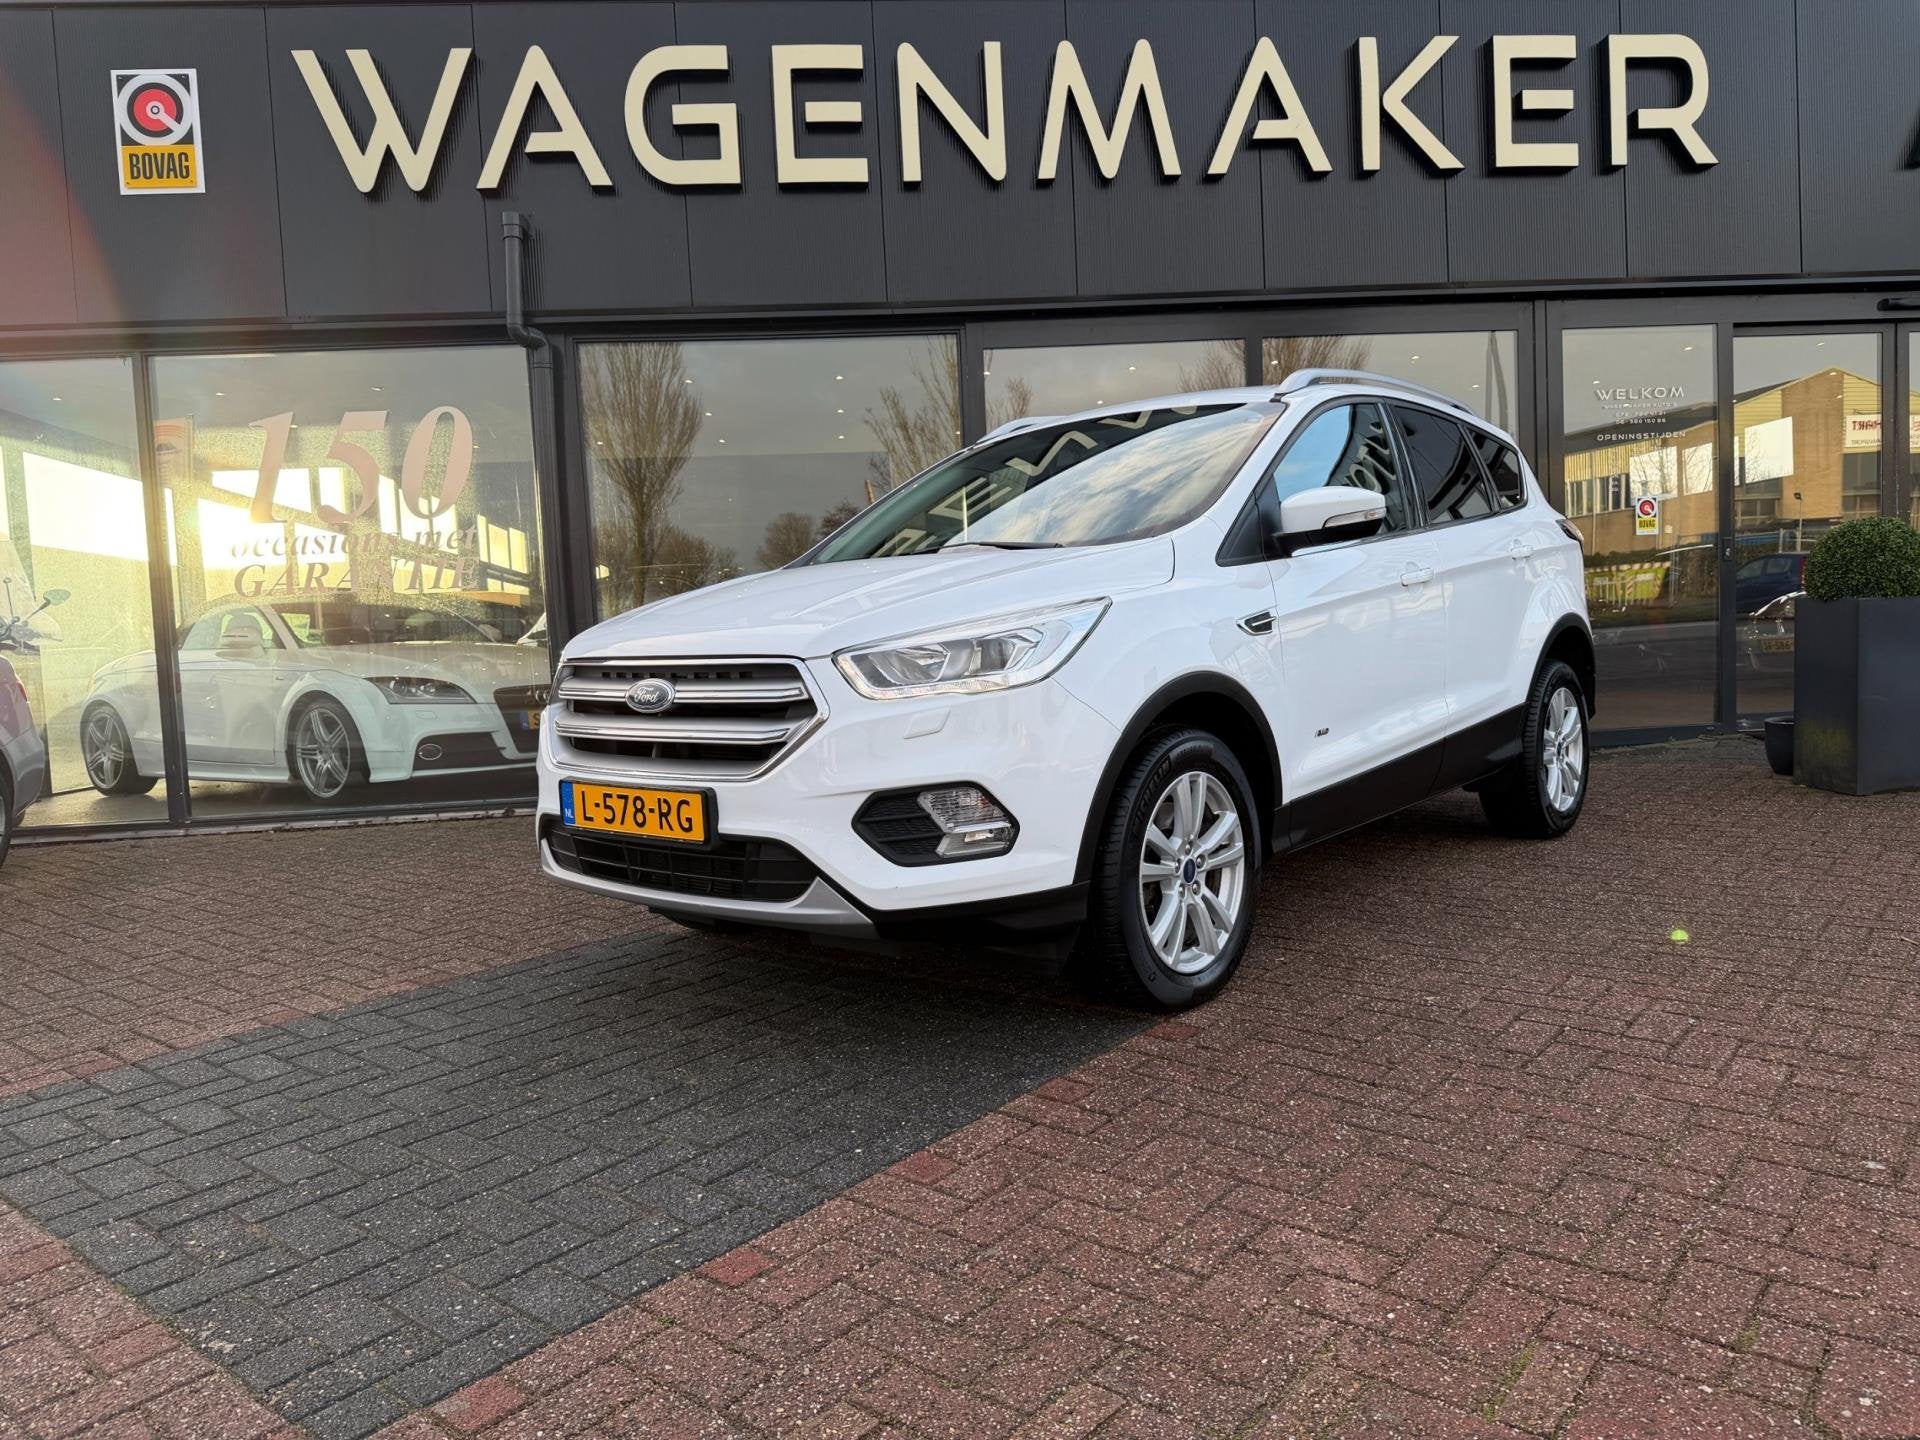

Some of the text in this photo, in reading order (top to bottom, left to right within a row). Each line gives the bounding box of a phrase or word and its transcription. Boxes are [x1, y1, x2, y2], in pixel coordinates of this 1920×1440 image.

[291, 34, 1719, 193] WAGENMAKER
[129, 152, 190, 180] BOVAG
[1596, 386, 1685, 401] WELKOM
[1596, 431, 1686, 441] OPENINGSTIJDEN
[248, 405, 473, 524] 150
[415, 522, 478, 550] met
[234, 556, 481, 598] GARANTIE
[634, 687, 659, 703] Ford
[564, 807, 574, 819] NL
[581, 790, 693, 834] L-578-RG
